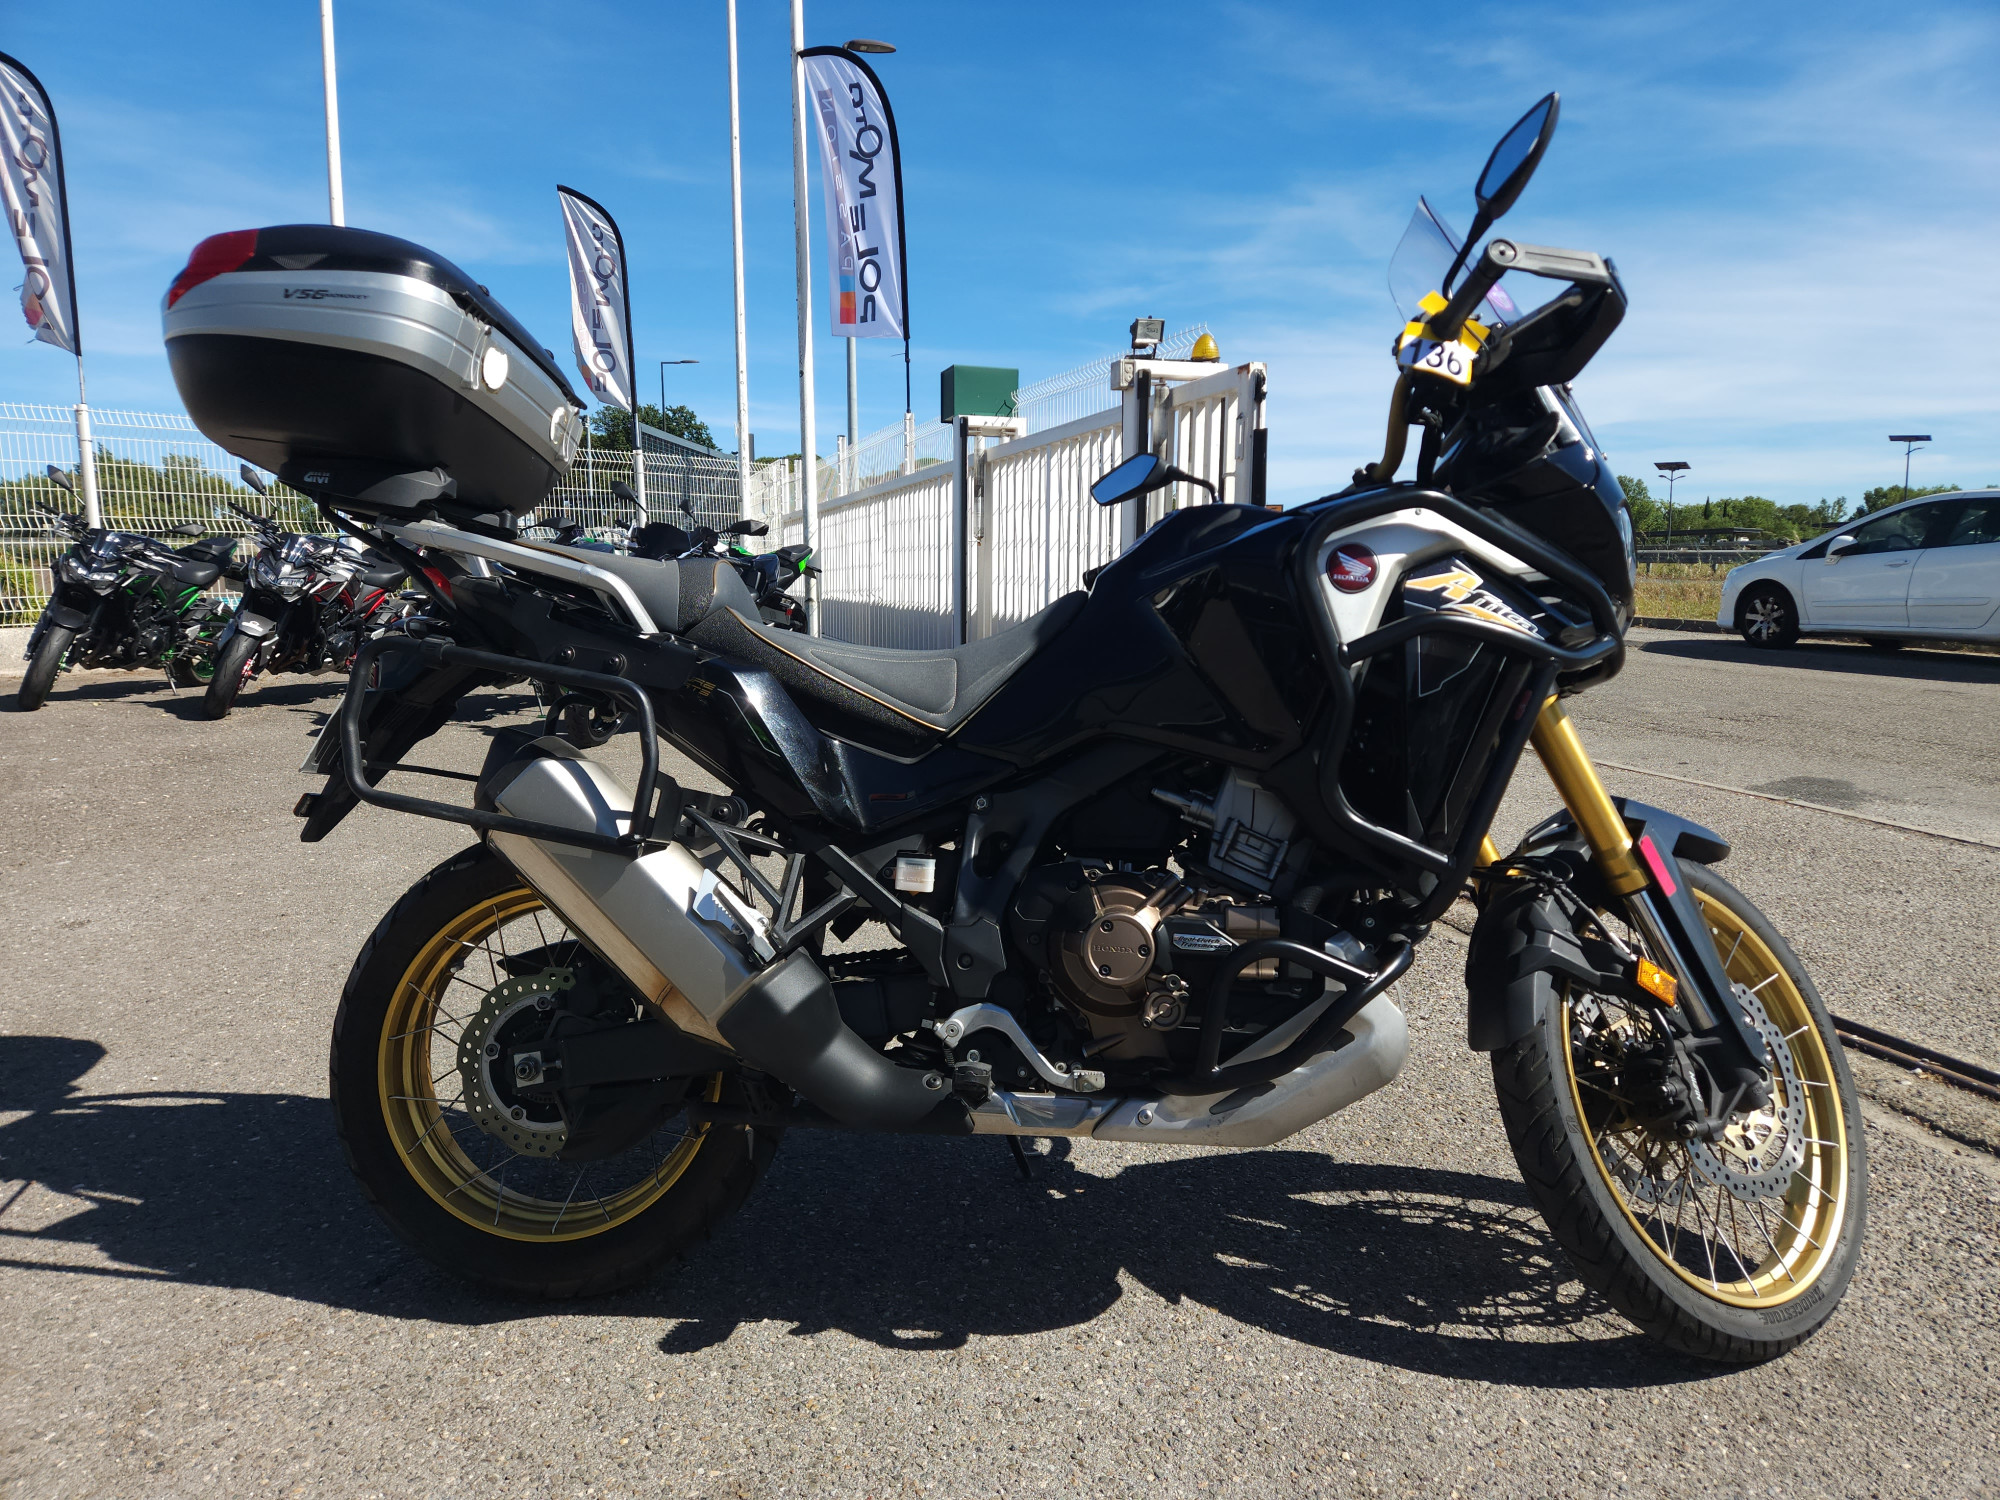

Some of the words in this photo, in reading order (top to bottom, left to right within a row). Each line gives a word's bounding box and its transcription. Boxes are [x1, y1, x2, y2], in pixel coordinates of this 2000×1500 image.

[1409, 339, 1462, 376] 136
[1333, 573, 1371, 584] HONDA
[1092, 945, 1137, 955] HONDA
[1761, 1286, 1826, 1326] BRIDGESTONE
